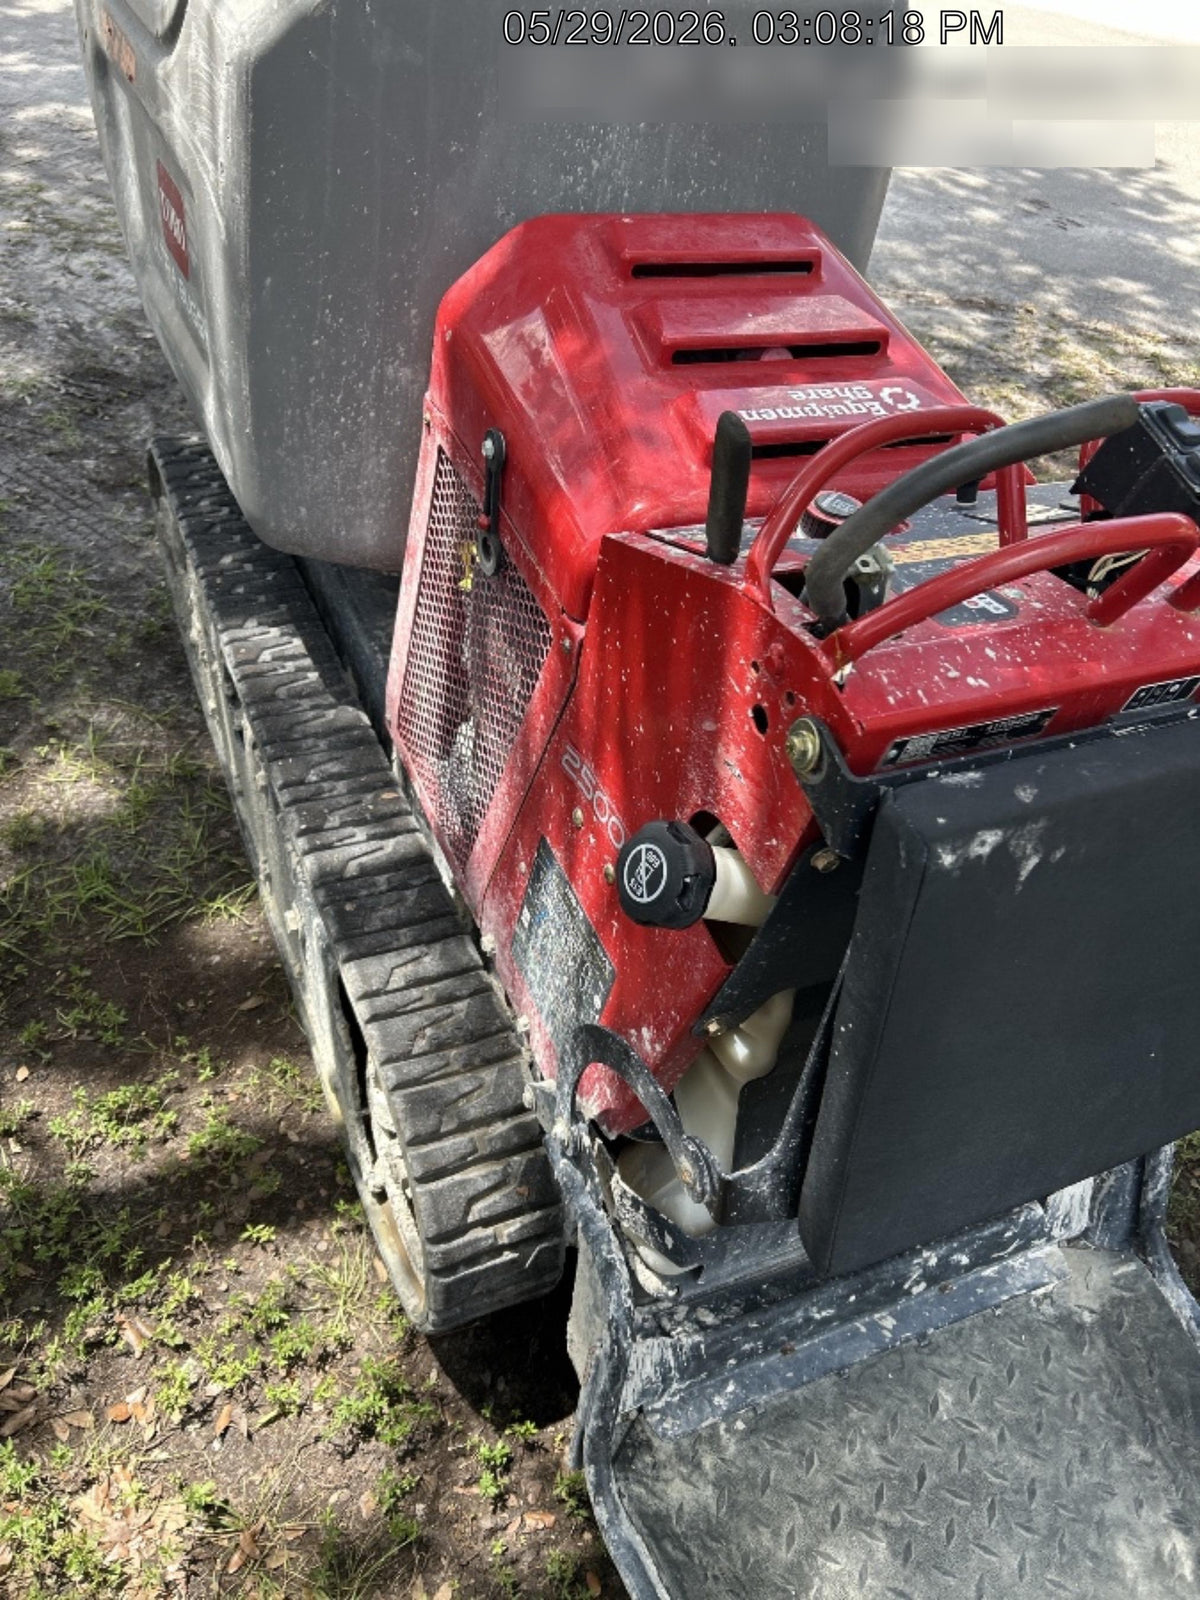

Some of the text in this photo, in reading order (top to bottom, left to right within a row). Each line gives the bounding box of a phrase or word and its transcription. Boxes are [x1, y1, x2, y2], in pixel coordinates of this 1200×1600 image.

[788, 385, 873, 400] Share
[737, 400, 888, 421] Equipmen
[561, 745, 625, 848] 2500
